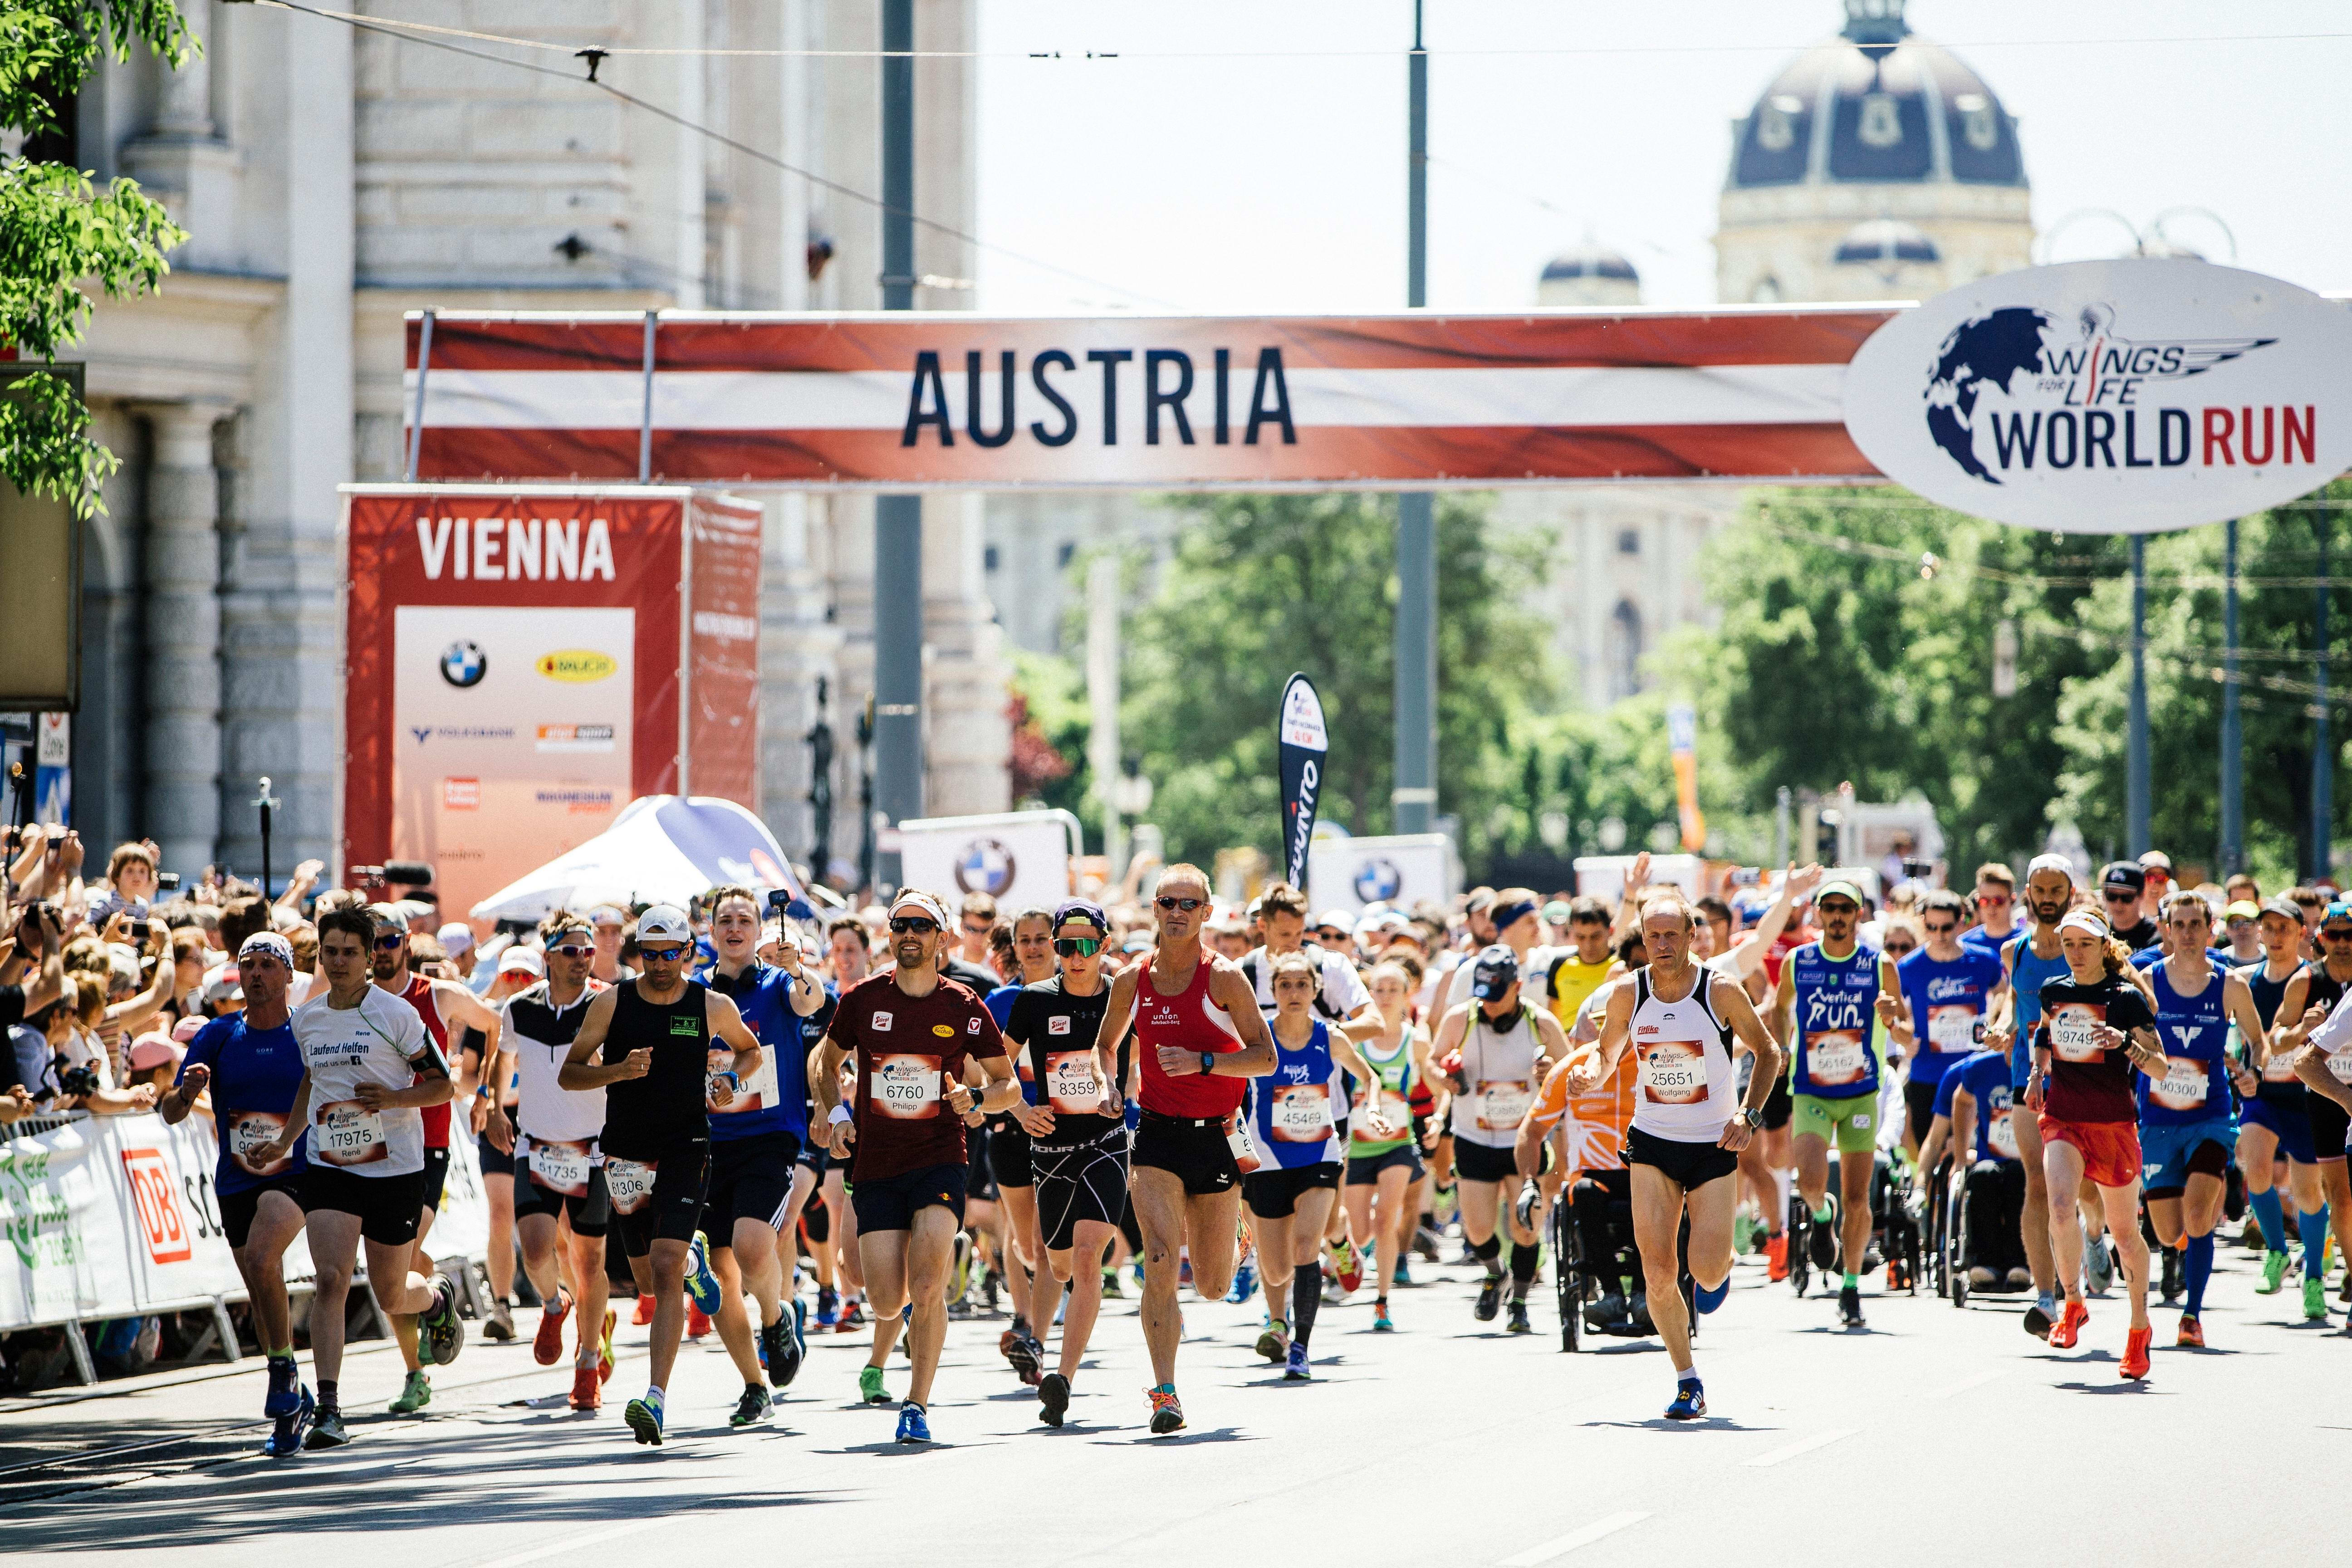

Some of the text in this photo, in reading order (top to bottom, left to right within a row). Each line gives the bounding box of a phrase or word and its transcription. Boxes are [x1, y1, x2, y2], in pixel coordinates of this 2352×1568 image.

[2045, 347, 2186, 375] WINGS
[902, 348, 1298, 448] AUSTRIA
[2036, 377, 2144, 406] FOR LIFE
[1991, 405, 2316, 469] WORLD RUN
[416, 516, 617, 582] VIENNA
[935, 1026, 953, 1035] Recheis
[2058, 1030, 2094, 1045] 39749
[310, 1041, 369, 1056] Laufend Helfen
[314, 1060, 328, 1068] Find
[1651, 1072, 1693, 1085] 25651
[887, 1085, 924, 1099] 6760
[1059, 1081, 1095, 1095] 8359
[1657, 1089, 1690, 1097] Wolfgang
[2160, 1080, 2197, 1096] 90300
[892, 1102, 917, 1111] Philipp
[1283, 1112, 1321, 1125] 45469
[329, 1129, 372, 1148] 17975
[341, 1148, 361, 1157] René
[612, 1180, 643, 1196] 61306
[133, 1166, 180, 1244] DB
[617, 1196, 637, 1206] Christian
